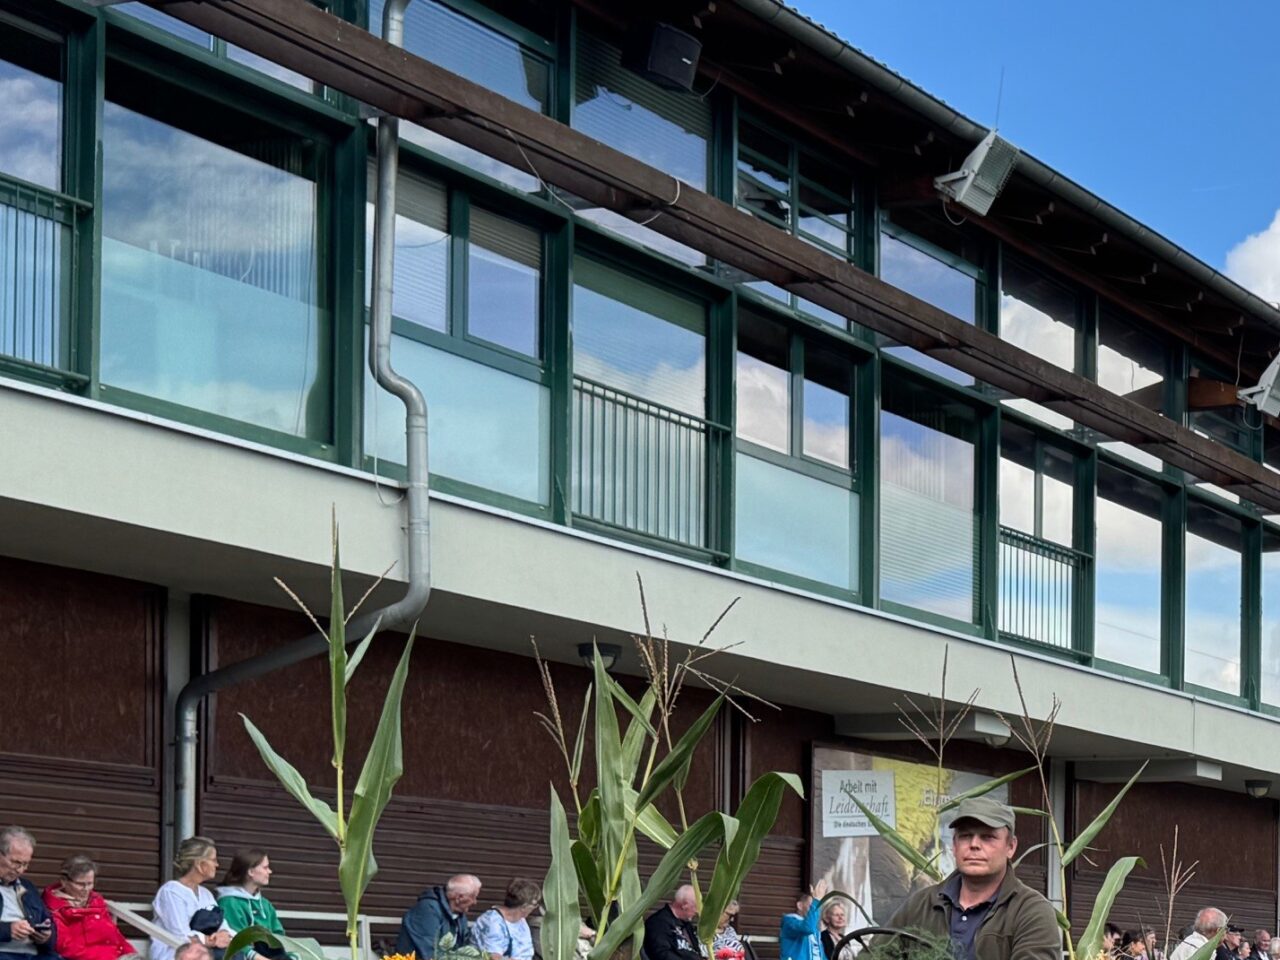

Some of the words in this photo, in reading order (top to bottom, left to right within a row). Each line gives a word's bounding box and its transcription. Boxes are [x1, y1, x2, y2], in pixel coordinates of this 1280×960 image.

[840, 779, 863, 793] Arbeit
[865, 780, 878, 793] mit
[829, 795, 889, 818] Leidenhaft
